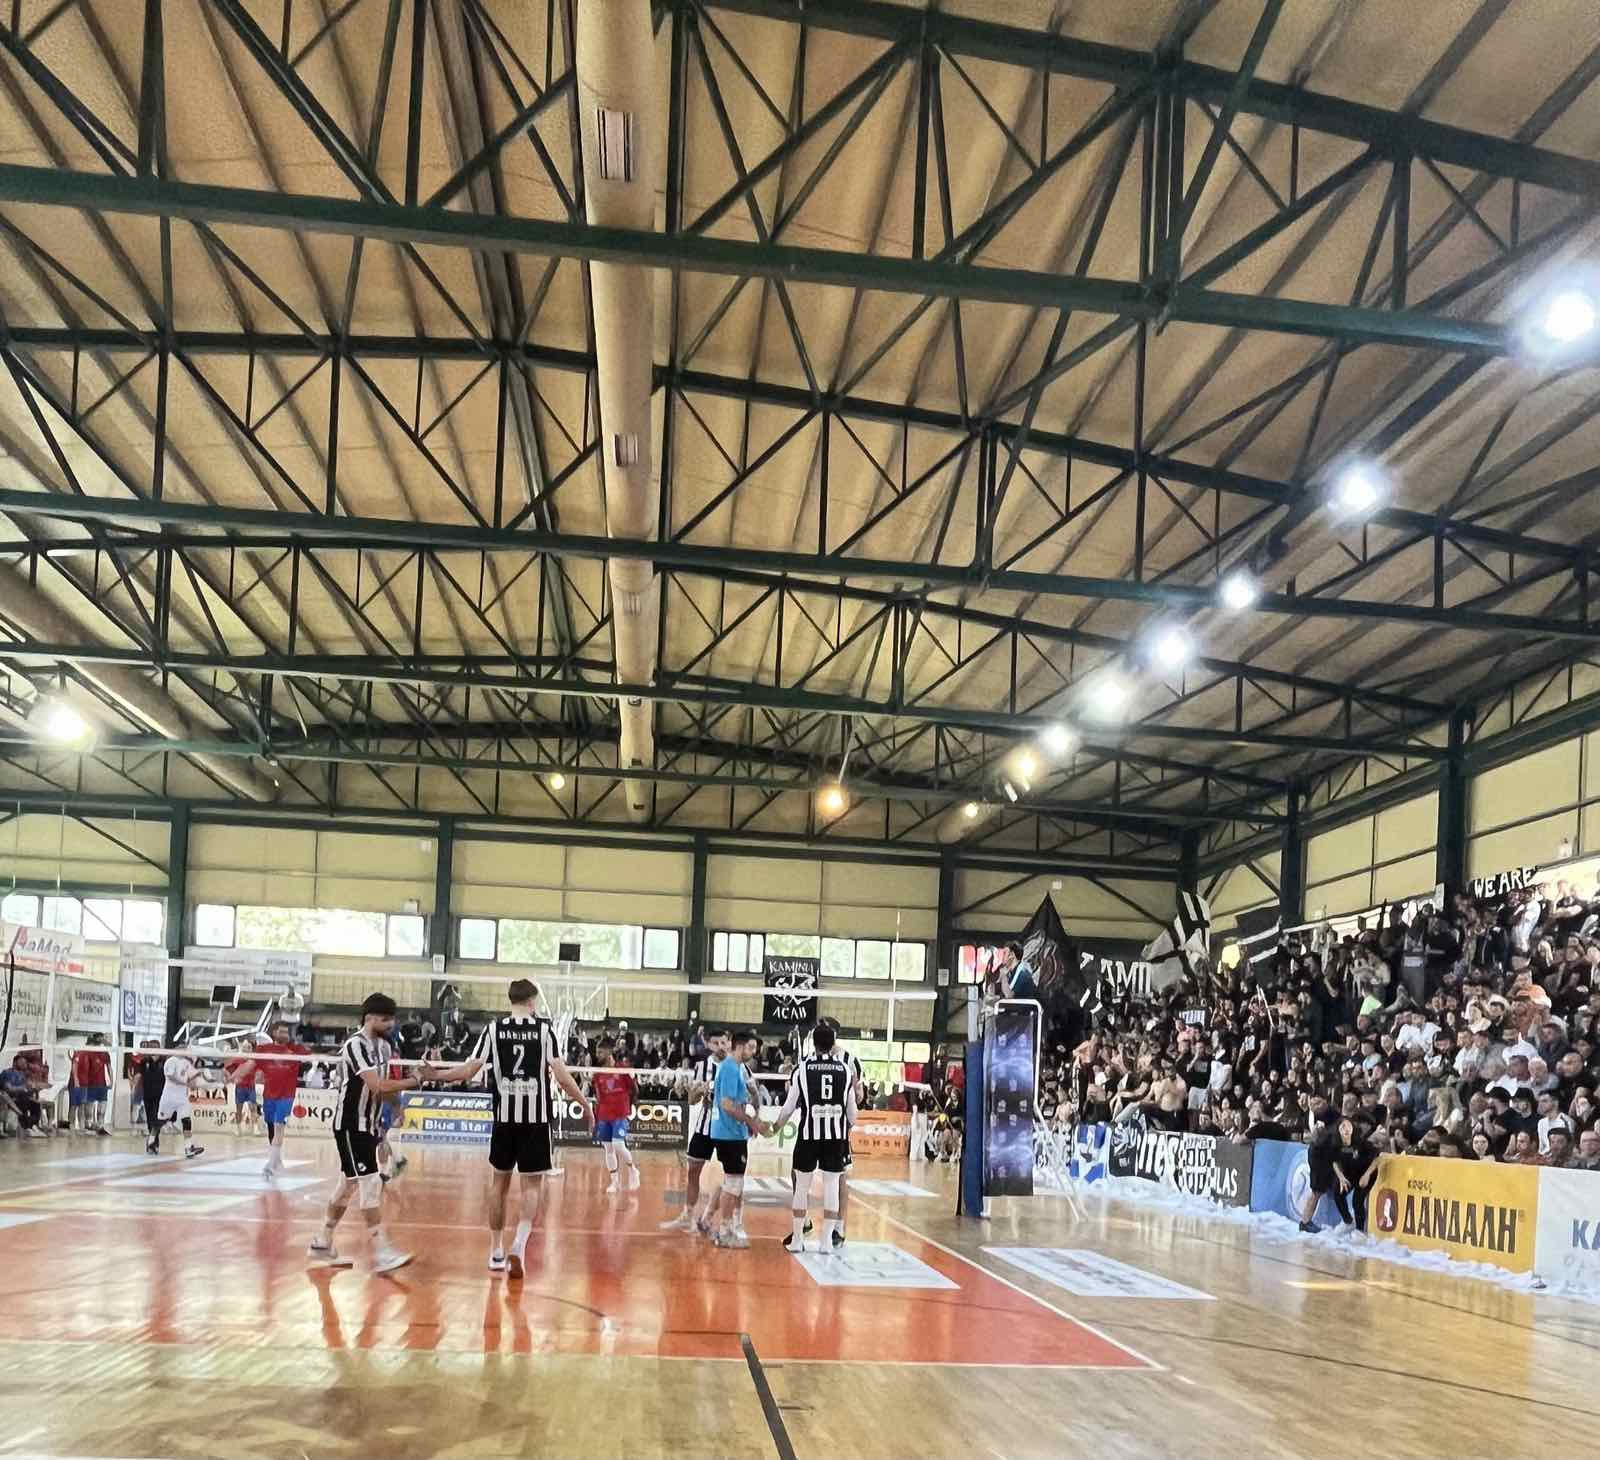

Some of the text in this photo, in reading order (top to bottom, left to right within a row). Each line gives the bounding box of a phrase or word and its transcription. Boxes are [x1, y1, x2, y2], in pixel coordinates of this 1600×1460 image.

[1474, 866, 1534, 898] WE ARE
[513, 1044, 525, 1076] 2
[821, 1074, 833, 1100] 6
[1402, 1194, 1518, 1254] ΔΑΝΔΑΛΗ
